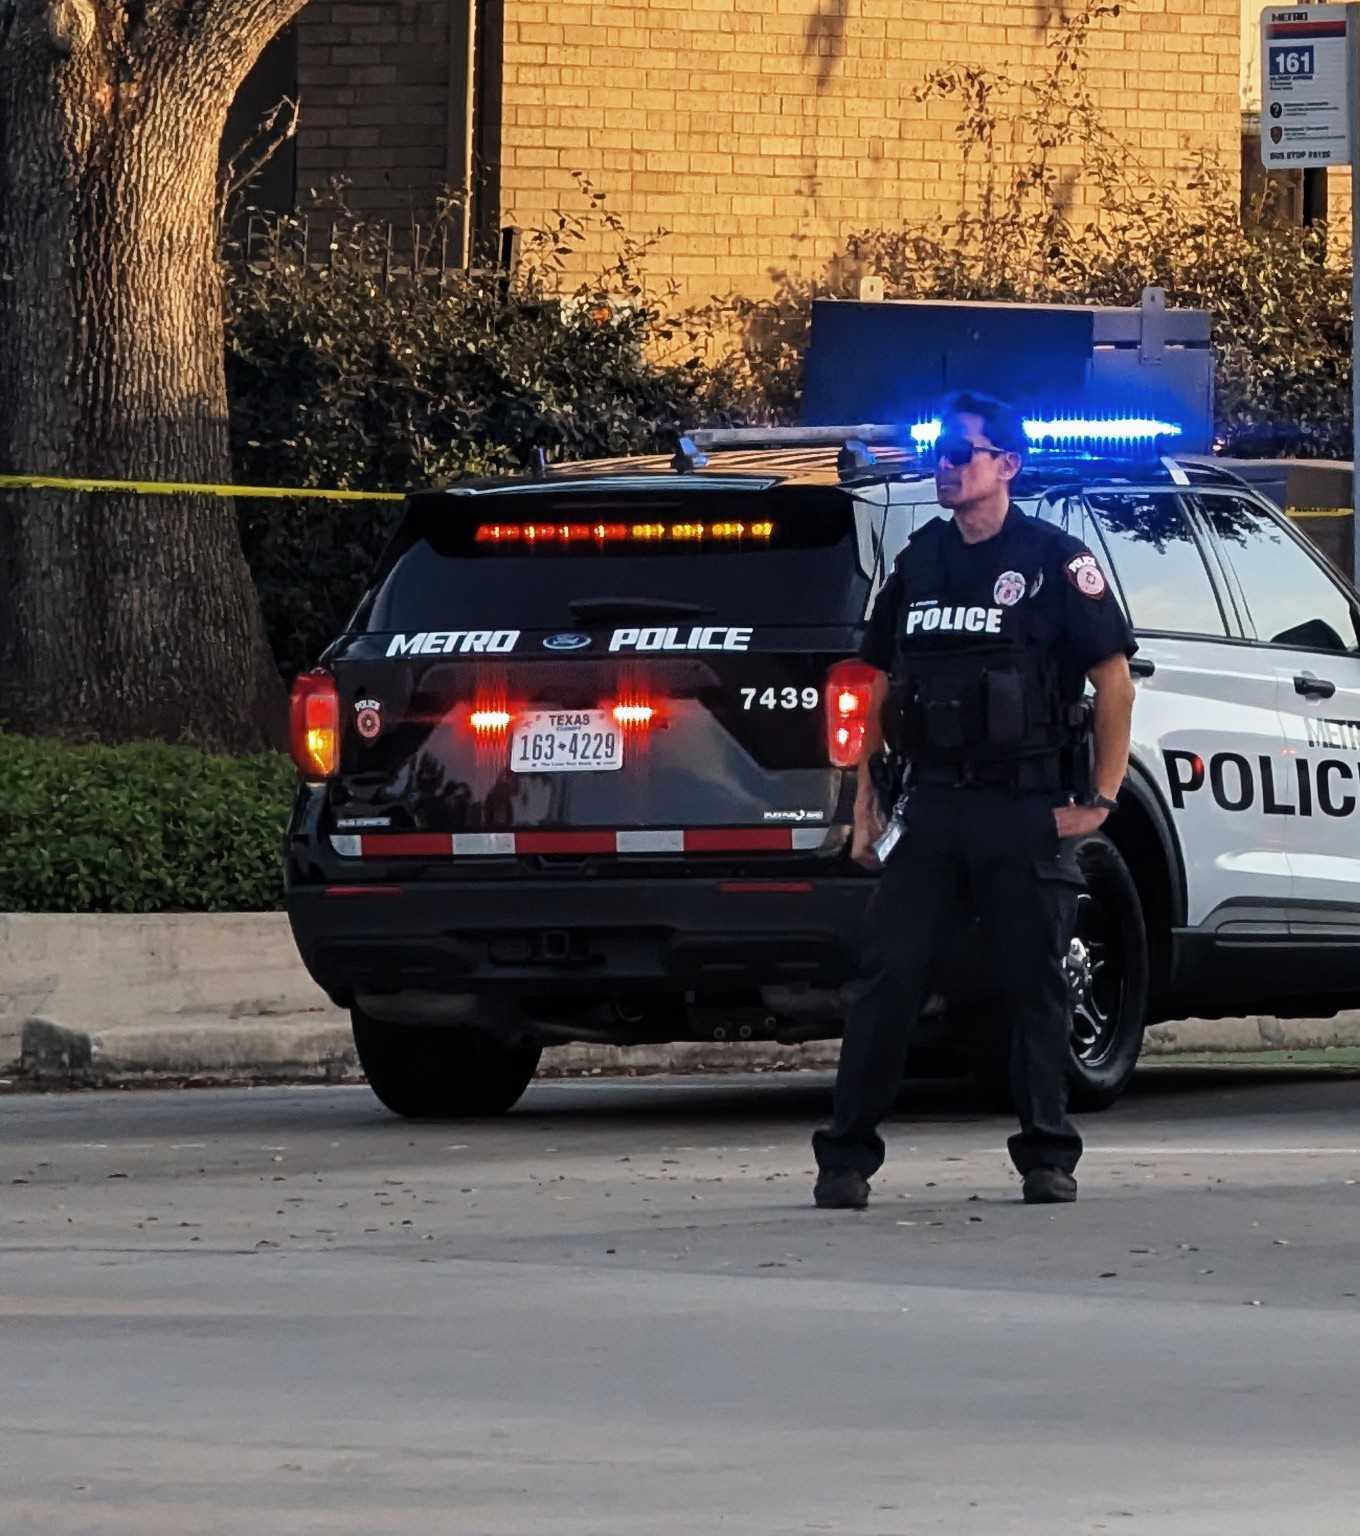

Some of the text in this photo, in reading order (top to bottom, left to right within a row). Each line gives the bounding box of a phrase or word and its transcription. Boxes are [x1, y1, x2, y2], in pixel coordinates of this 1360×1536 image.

[1276, 52, 1310, 73] 161
[906, 606, 1003, 634] POLICE
[386, 630, 520, 657] METRO
[608, 627, 753, 652] POLICE
[740, 687, 818, 710] 7439
[549, 714, 590, 726] TEXAS
